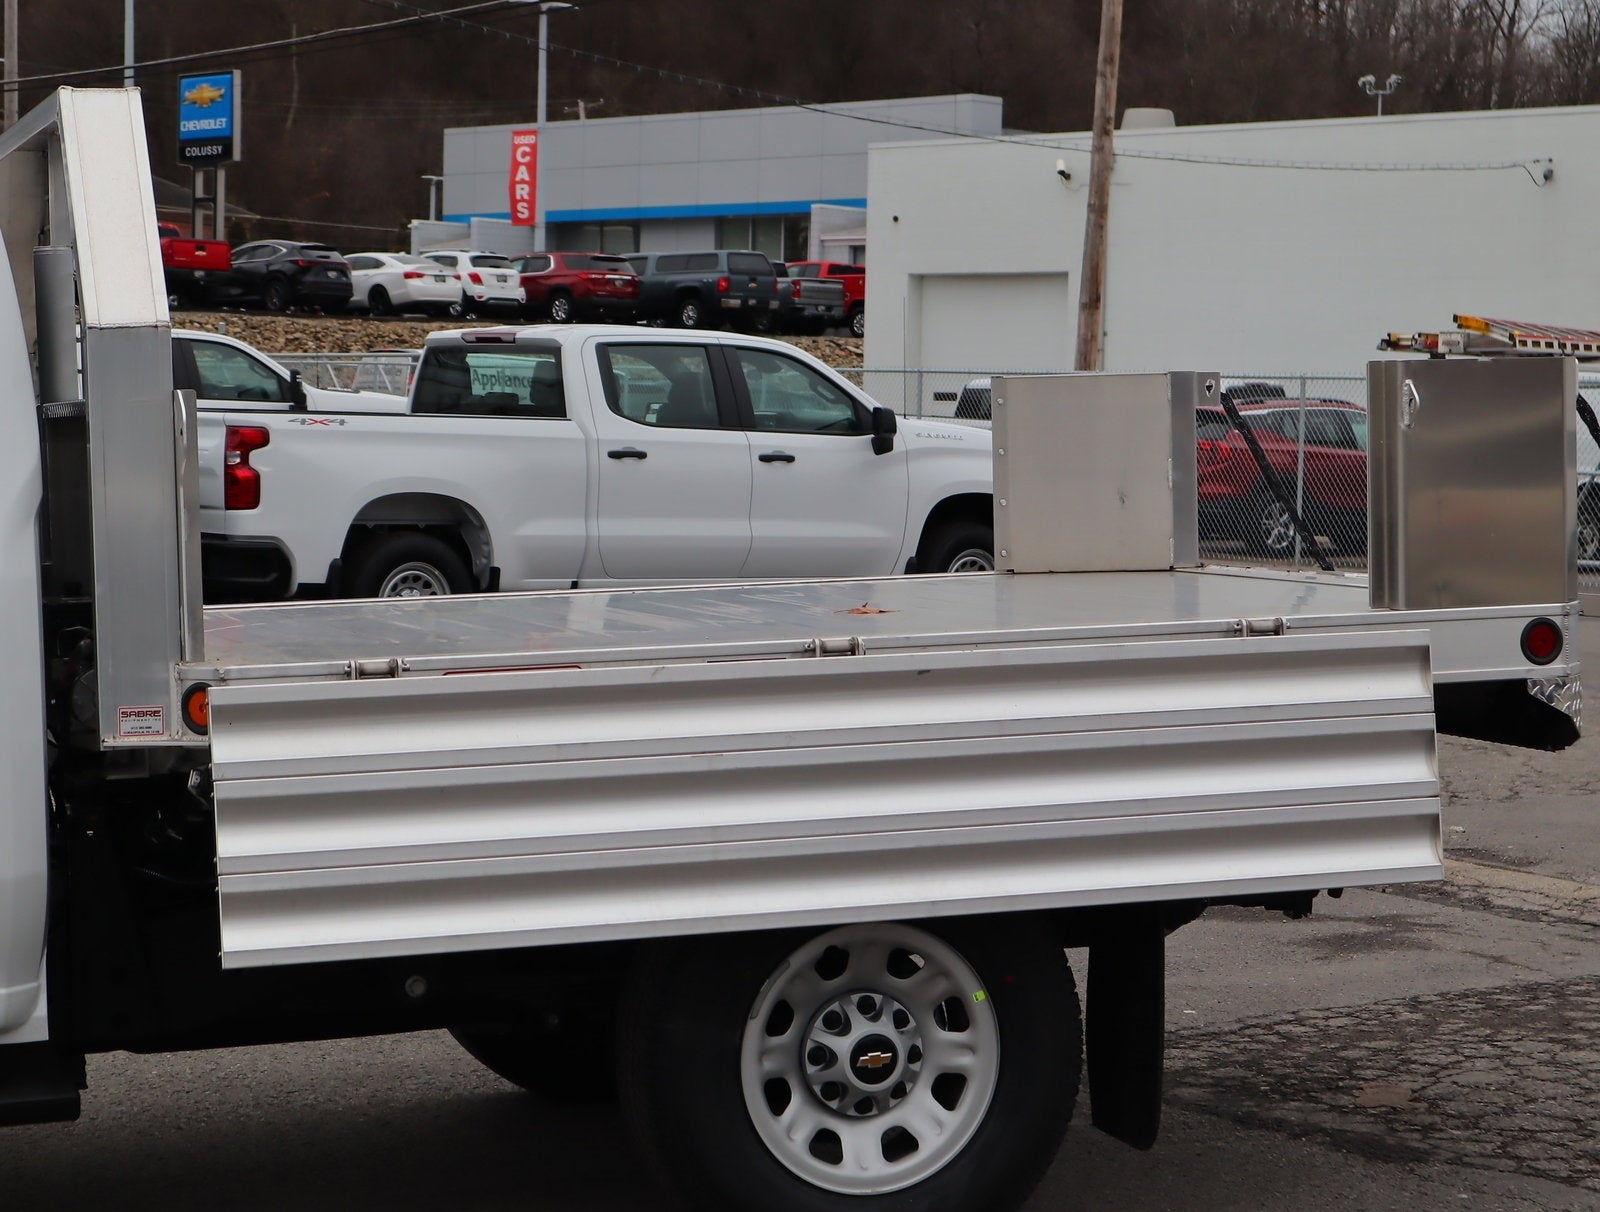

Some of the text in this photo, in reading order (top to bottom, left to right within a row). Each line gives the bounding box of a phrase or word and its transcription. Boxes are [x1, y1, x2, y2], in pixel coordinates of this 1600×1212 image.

[181, 118, 227, 131] CHEVROLET
[513, 135, 536, 144] USED
[185, 145, 223, 156] COLUSSY
[515, 146, 531, 219] CARS
[121, 710, 161, 718] SABRE
